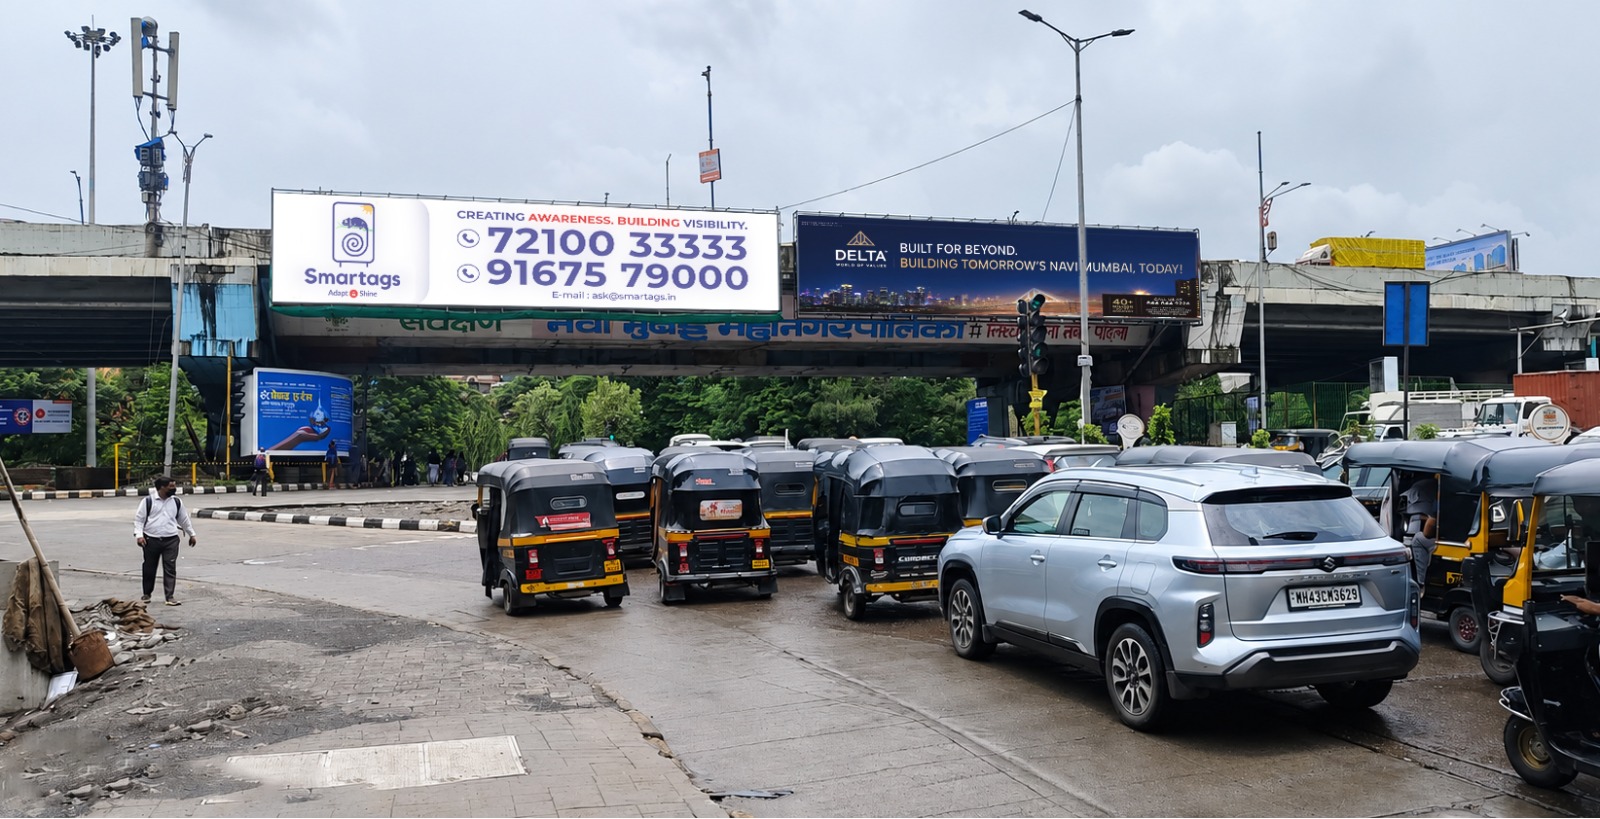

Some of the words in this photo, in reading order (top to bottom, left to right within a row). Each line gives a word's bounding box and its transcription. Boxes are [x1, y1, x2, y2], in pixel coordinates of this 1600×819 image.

[456, 210, 525, 222] CREATING
[528, 213, 614, 225] AWARENESS.
[617, 216, 680, 228] BUILDING
[682, 219, 748, 230] VISIBILITY.
[488, 226, 615, 257] 72100
[628, 231, 747, 261] 33333
[899, 242, 934, 254] BUILT
[936, 243, 962, 255] FOR
[964, 244, 1018, 256] BEYOND.
[835, 249, 886, 262] DELTA
[486, 258, 607, 288] 91675
[620, 262, 749, 291] 79000
[900, 257, 959, 270] BUILDING
[1049, 261, 1079, 272] NAVI
[1084, 262, 1136, 274] MUMBAI,
[1138, 263, 1184, 275] TODAY!
[304, 268, 401, 291] Smartags
[328, 289, 349, 298] Adapt
[359, 290, 378, 298] Shine
[552, 291, 585, 300] E-mail
[591, 292, 677, 302] ask@smartags.in
[1296, 588, 1358, 604] MH43CM3629
